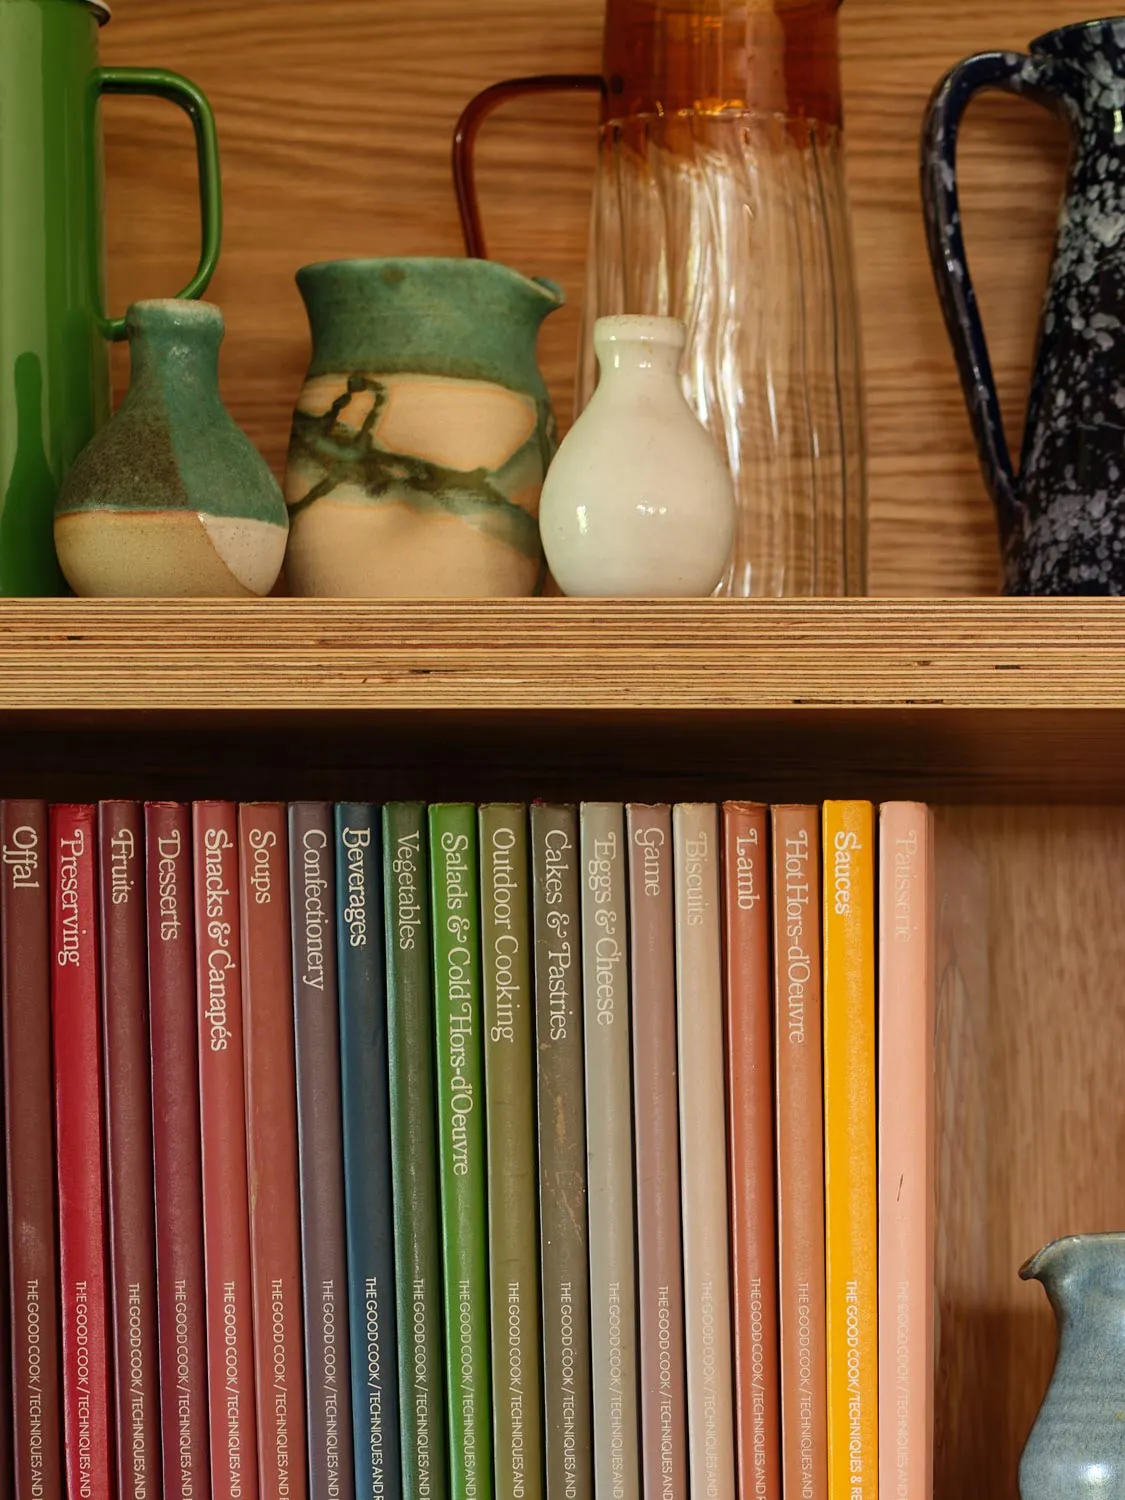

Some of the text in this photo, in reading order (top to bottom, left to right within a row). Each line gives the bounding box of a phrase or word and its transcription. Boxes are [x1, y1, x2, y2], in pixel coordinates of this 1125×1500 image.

[3, 826, 39, 888] Offal
[111, 829, 134, 904] Fruits
[249, 829, 276, 903] Soups
[441, 832, 468, 909] Salads
[635, 828, 664, 896] Game
[737, 829, 760, 909] Lamb
[786, 830, 807, 879] Hot
[835, 832, 861, 916] Sauces
[58, 829, 86, 966] Preserving
[158, 830, 181, 940] Desserts
[343, 827, 370, 946] Beverages
[394, 831, 421, 949] Vegetables
[686, 834, 708, 927] Biscuits
[895, 832, 916, 942] Patisserie
[303, 830, 328, 991] Confectionery
[447, 915, 469, 943] &
[589, 832, 619, 1025] Eggs & Cheese
[205, 829, 235, 1051] Snacks & Canapés
[491, 828, 520, 1042] Outdoor Cooking
[545, 830, 572, 1040] Cakes & Pastries
[448, 947, 471, 1000] Cold
[27, 1279, 39, 1301] THE
[76, 1280, 87, 1302] THE
[130, 1283, 141, 1305] THE
[224, 1281, 236, 1303] THE
[271, 1278, 283, 1300] THE
[323, 1280, 334, 1301] THE
[365, 1277, 377, 1299] THE
[509, 1282, 520, 1303] THE
[561, 1282, 572, 1303] THE
[28, 1302, 40, 1344] GOOD
[76, 1304, 88, 1346] GOOD
[130, 1306, 142, 1348] GOOD
[225, 1304, 237, 1346] GOOD
[272, 1302, 284, 1344] GOOD
[323, 1303, 335, 1345] GOOD
[366, 1300, 378, 1342] GOOD
[509, 1305, 521, 1347] GOOD
[561, 1305, 573, 1347] GOOD
[31, 1471, 43, 1496] AND
[80, 1472, 91, 1498] AND
[134, 1474, 145, 1500] AND
[230, 1472, 241, 1498] AND
[277, 1470, 289, 1496] AND
[327, 1471, 339, 1497] AND
[371, 1468, 383, 1494] AND
[513, 1473, 524, 1498] AND
[564, 1473, 576, 1499] AND
